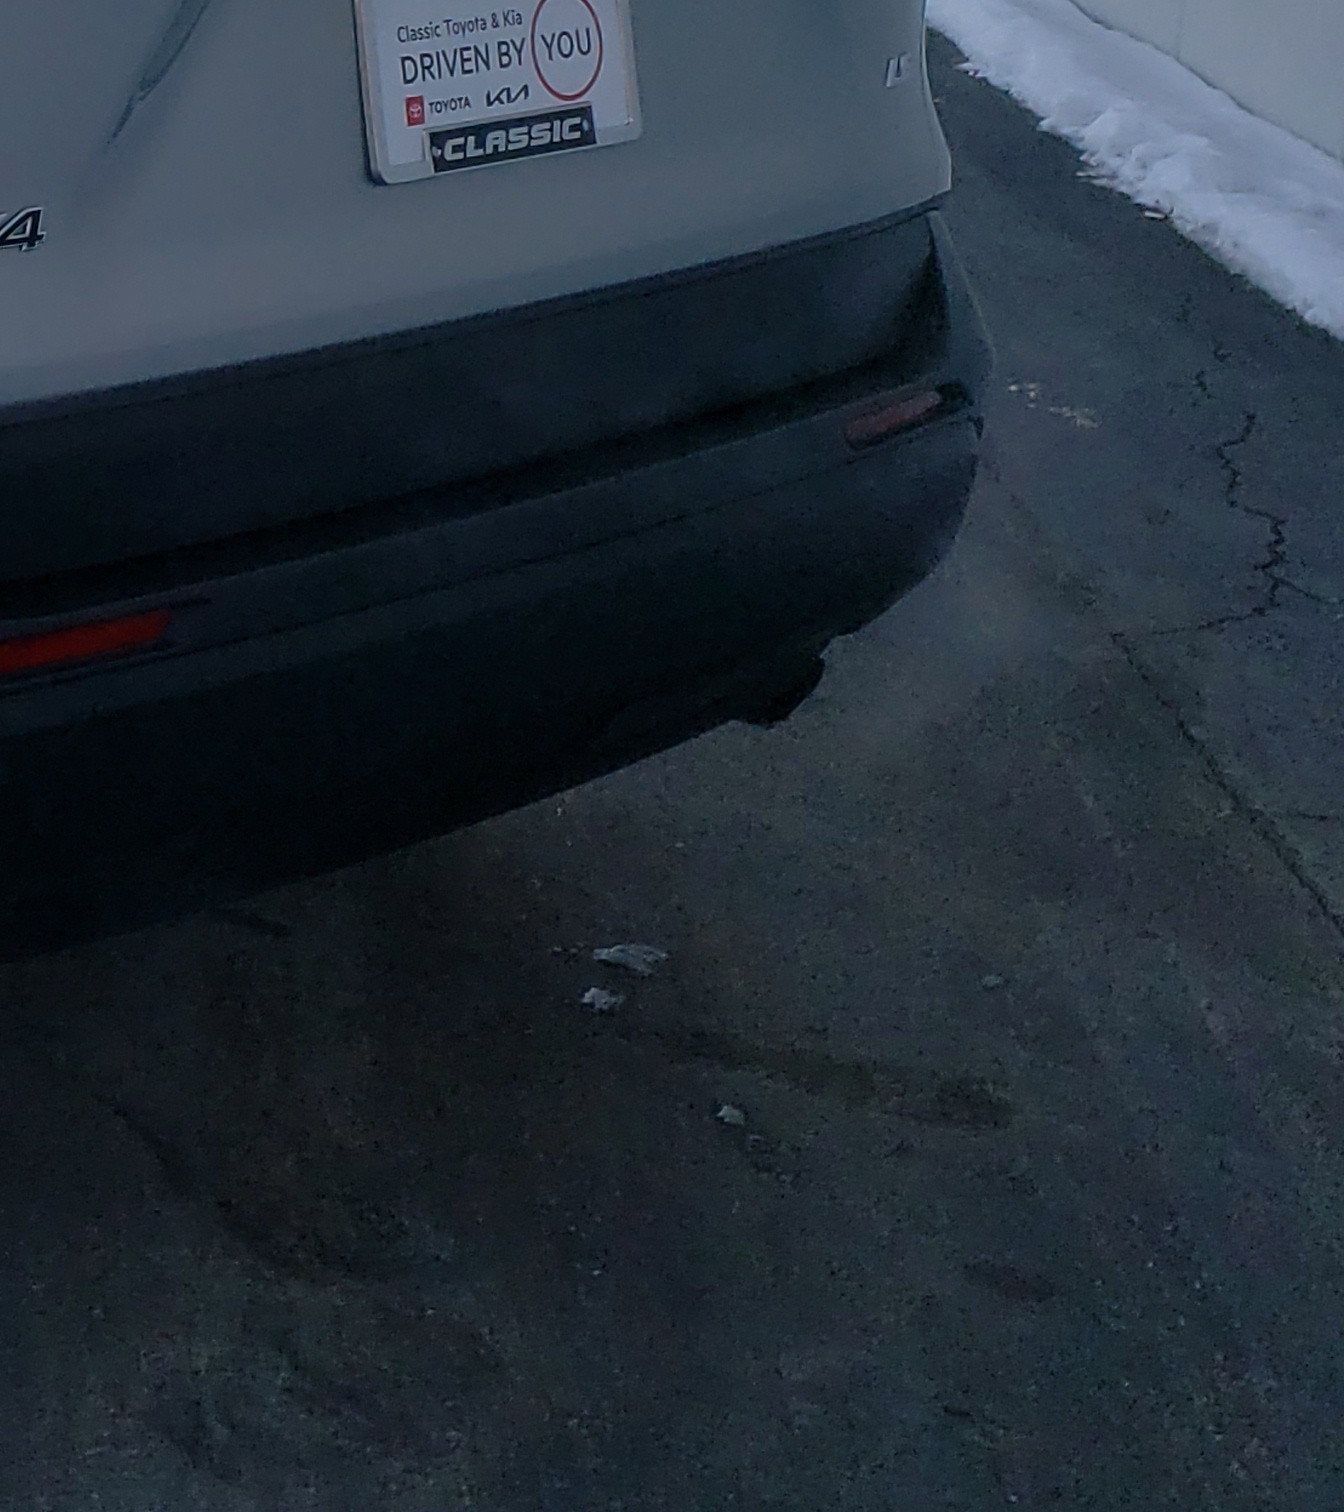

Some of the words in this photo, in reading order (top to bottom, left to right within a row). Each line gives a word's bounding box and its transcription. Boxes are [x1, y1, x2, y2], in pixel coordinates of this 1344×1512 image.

[397, 21, 441, 43] Classic
[443, 14, 488, 39] Toyota
[490, 13, 500, 28] &
[502, 8, 523, 27] Kia
[400, 42, 491, 85] DRIVEN
[497, 37, 527, 69] BY
[541, 27, 592, 61] YOU
[428, 96, 472, 114] TOYOTA
[443, 117, 582, 162] CLASSIC
